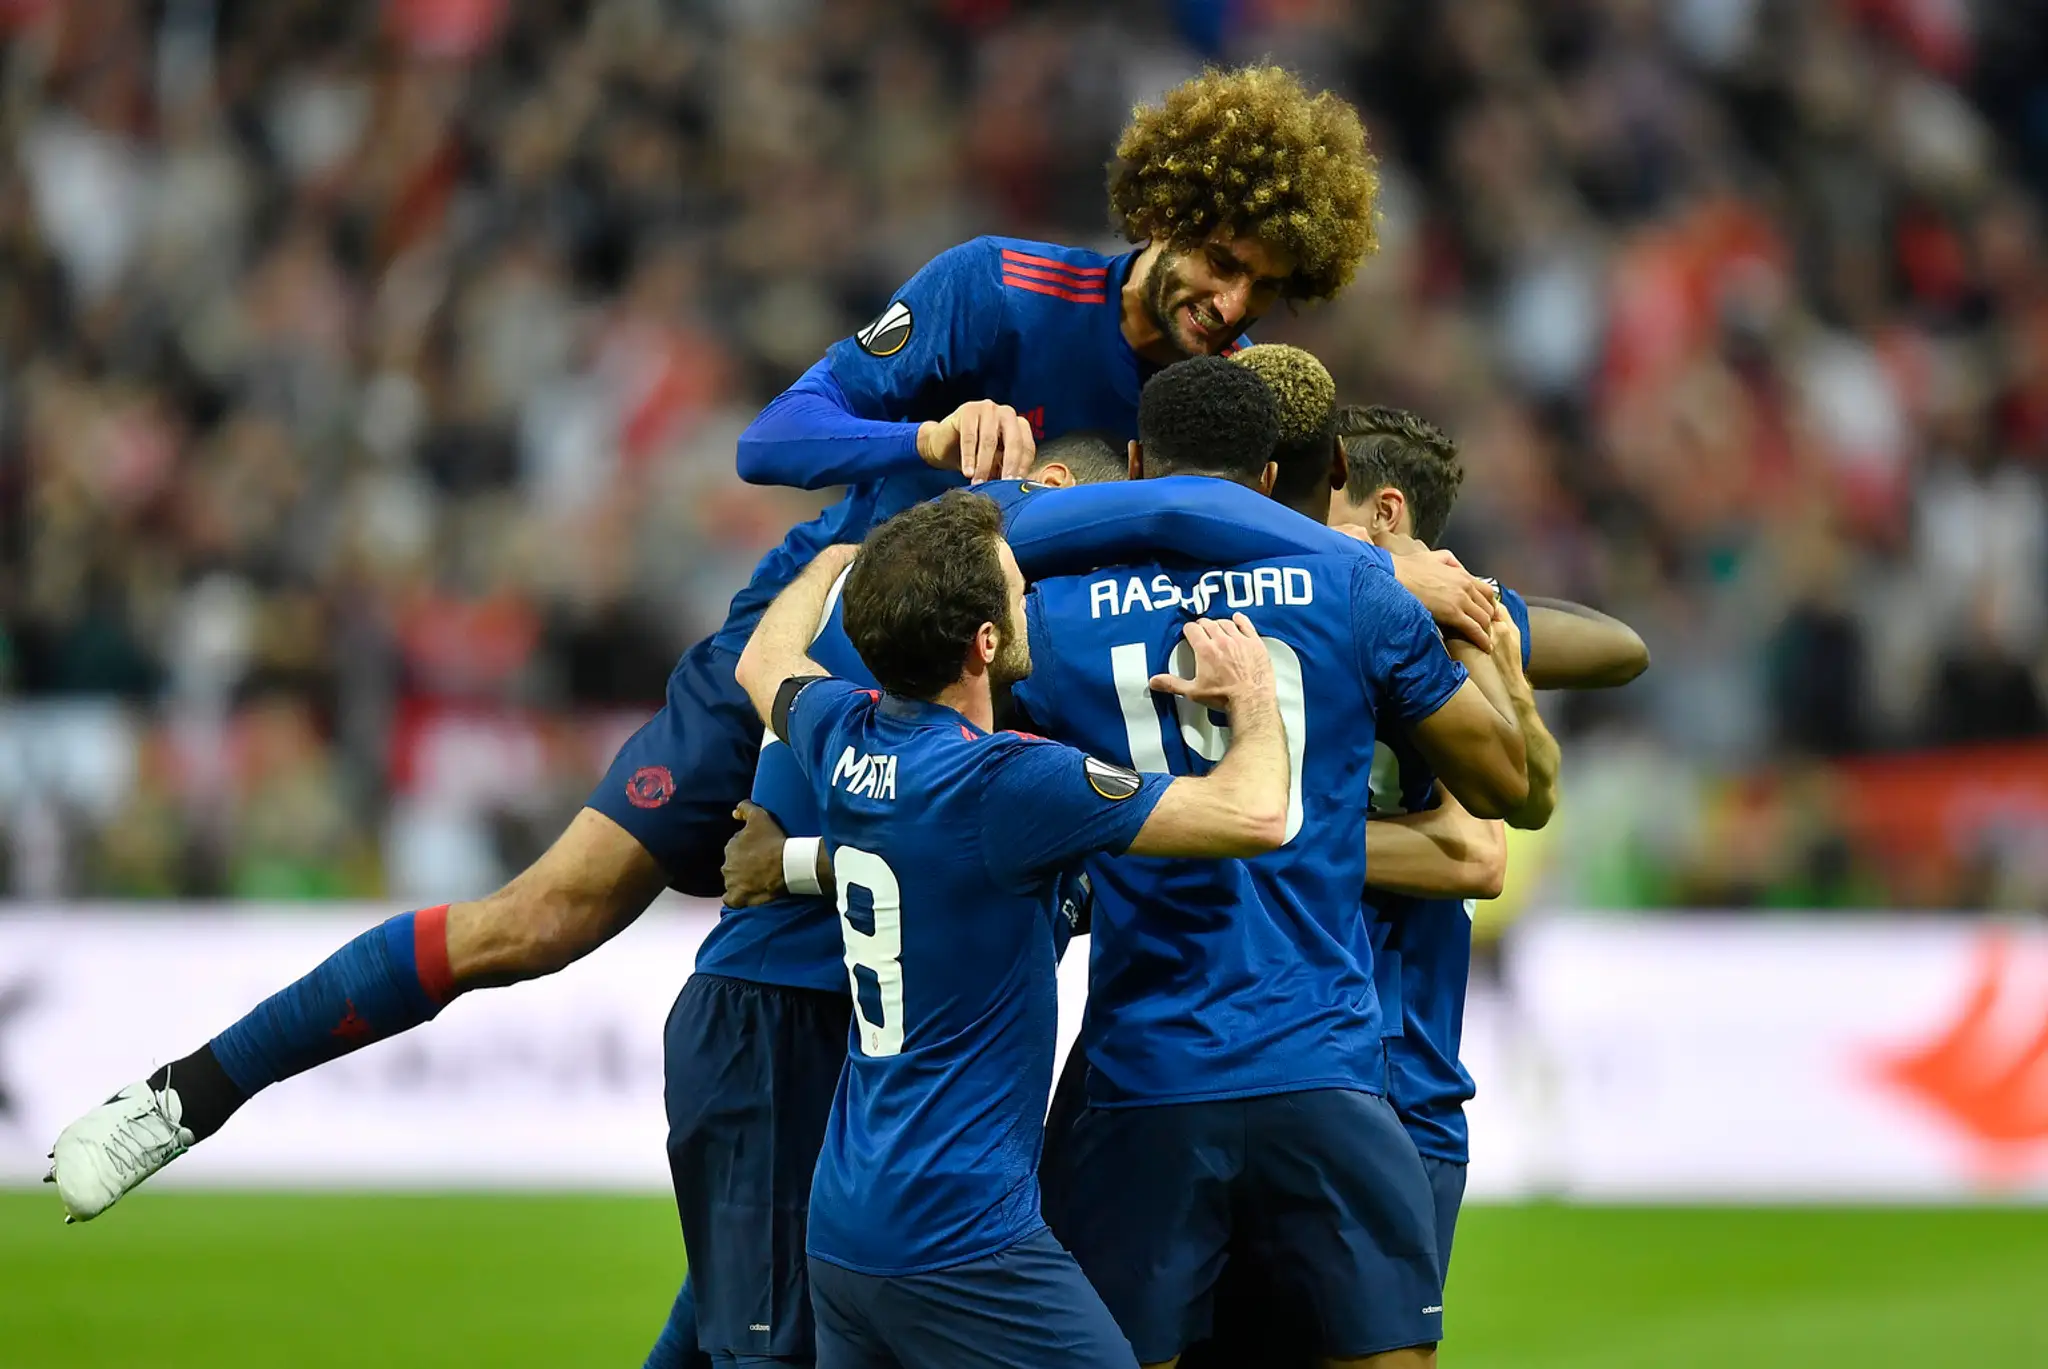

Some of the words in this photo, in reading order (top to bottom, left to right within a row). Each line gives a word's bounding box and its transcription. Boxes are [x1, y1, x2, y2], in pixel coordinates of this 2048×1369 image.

[1090, 567, 1313, 619] RASHFORD
[832, 745, 898, 800] MATA
[834, 845, 904, 1057] 8
